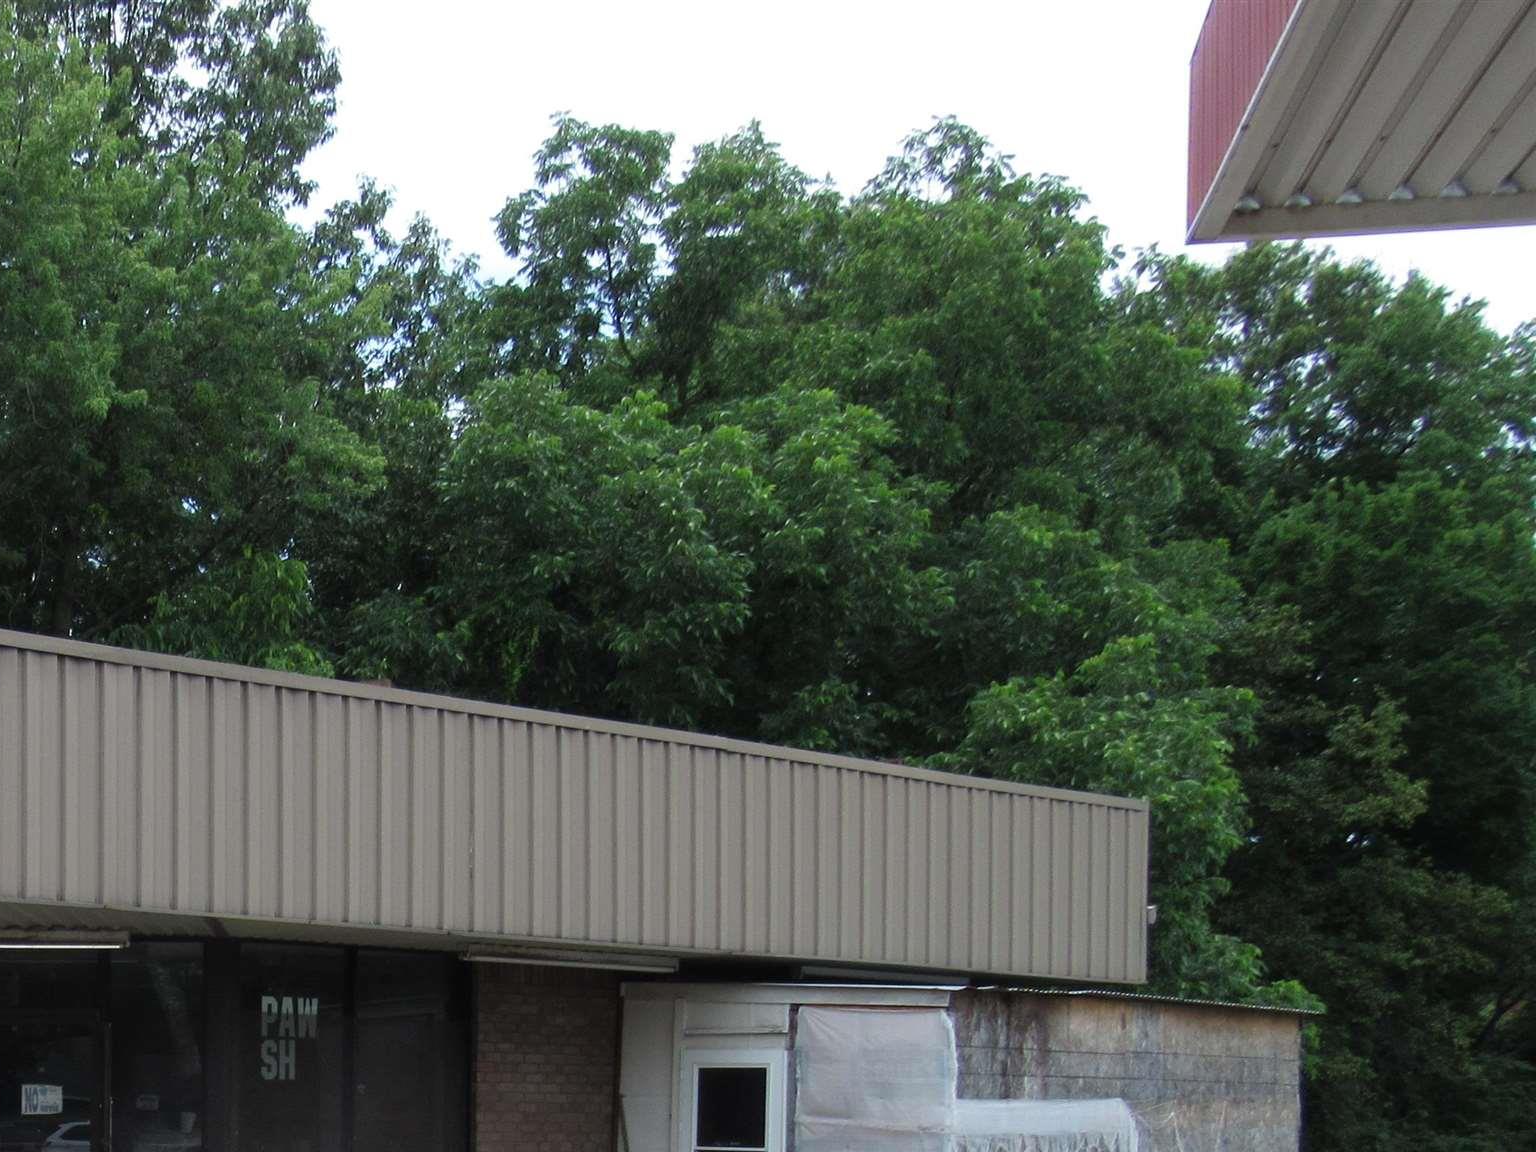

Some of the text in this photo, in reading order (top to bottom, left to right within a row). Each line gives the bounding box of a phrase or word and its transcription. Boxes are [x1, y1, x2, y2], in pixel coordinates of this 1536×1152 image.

[261, 995, 319, 1039] PAW
[260, 1039, 296, 1081] SH
[24, 1087, 39, 1113] NO
